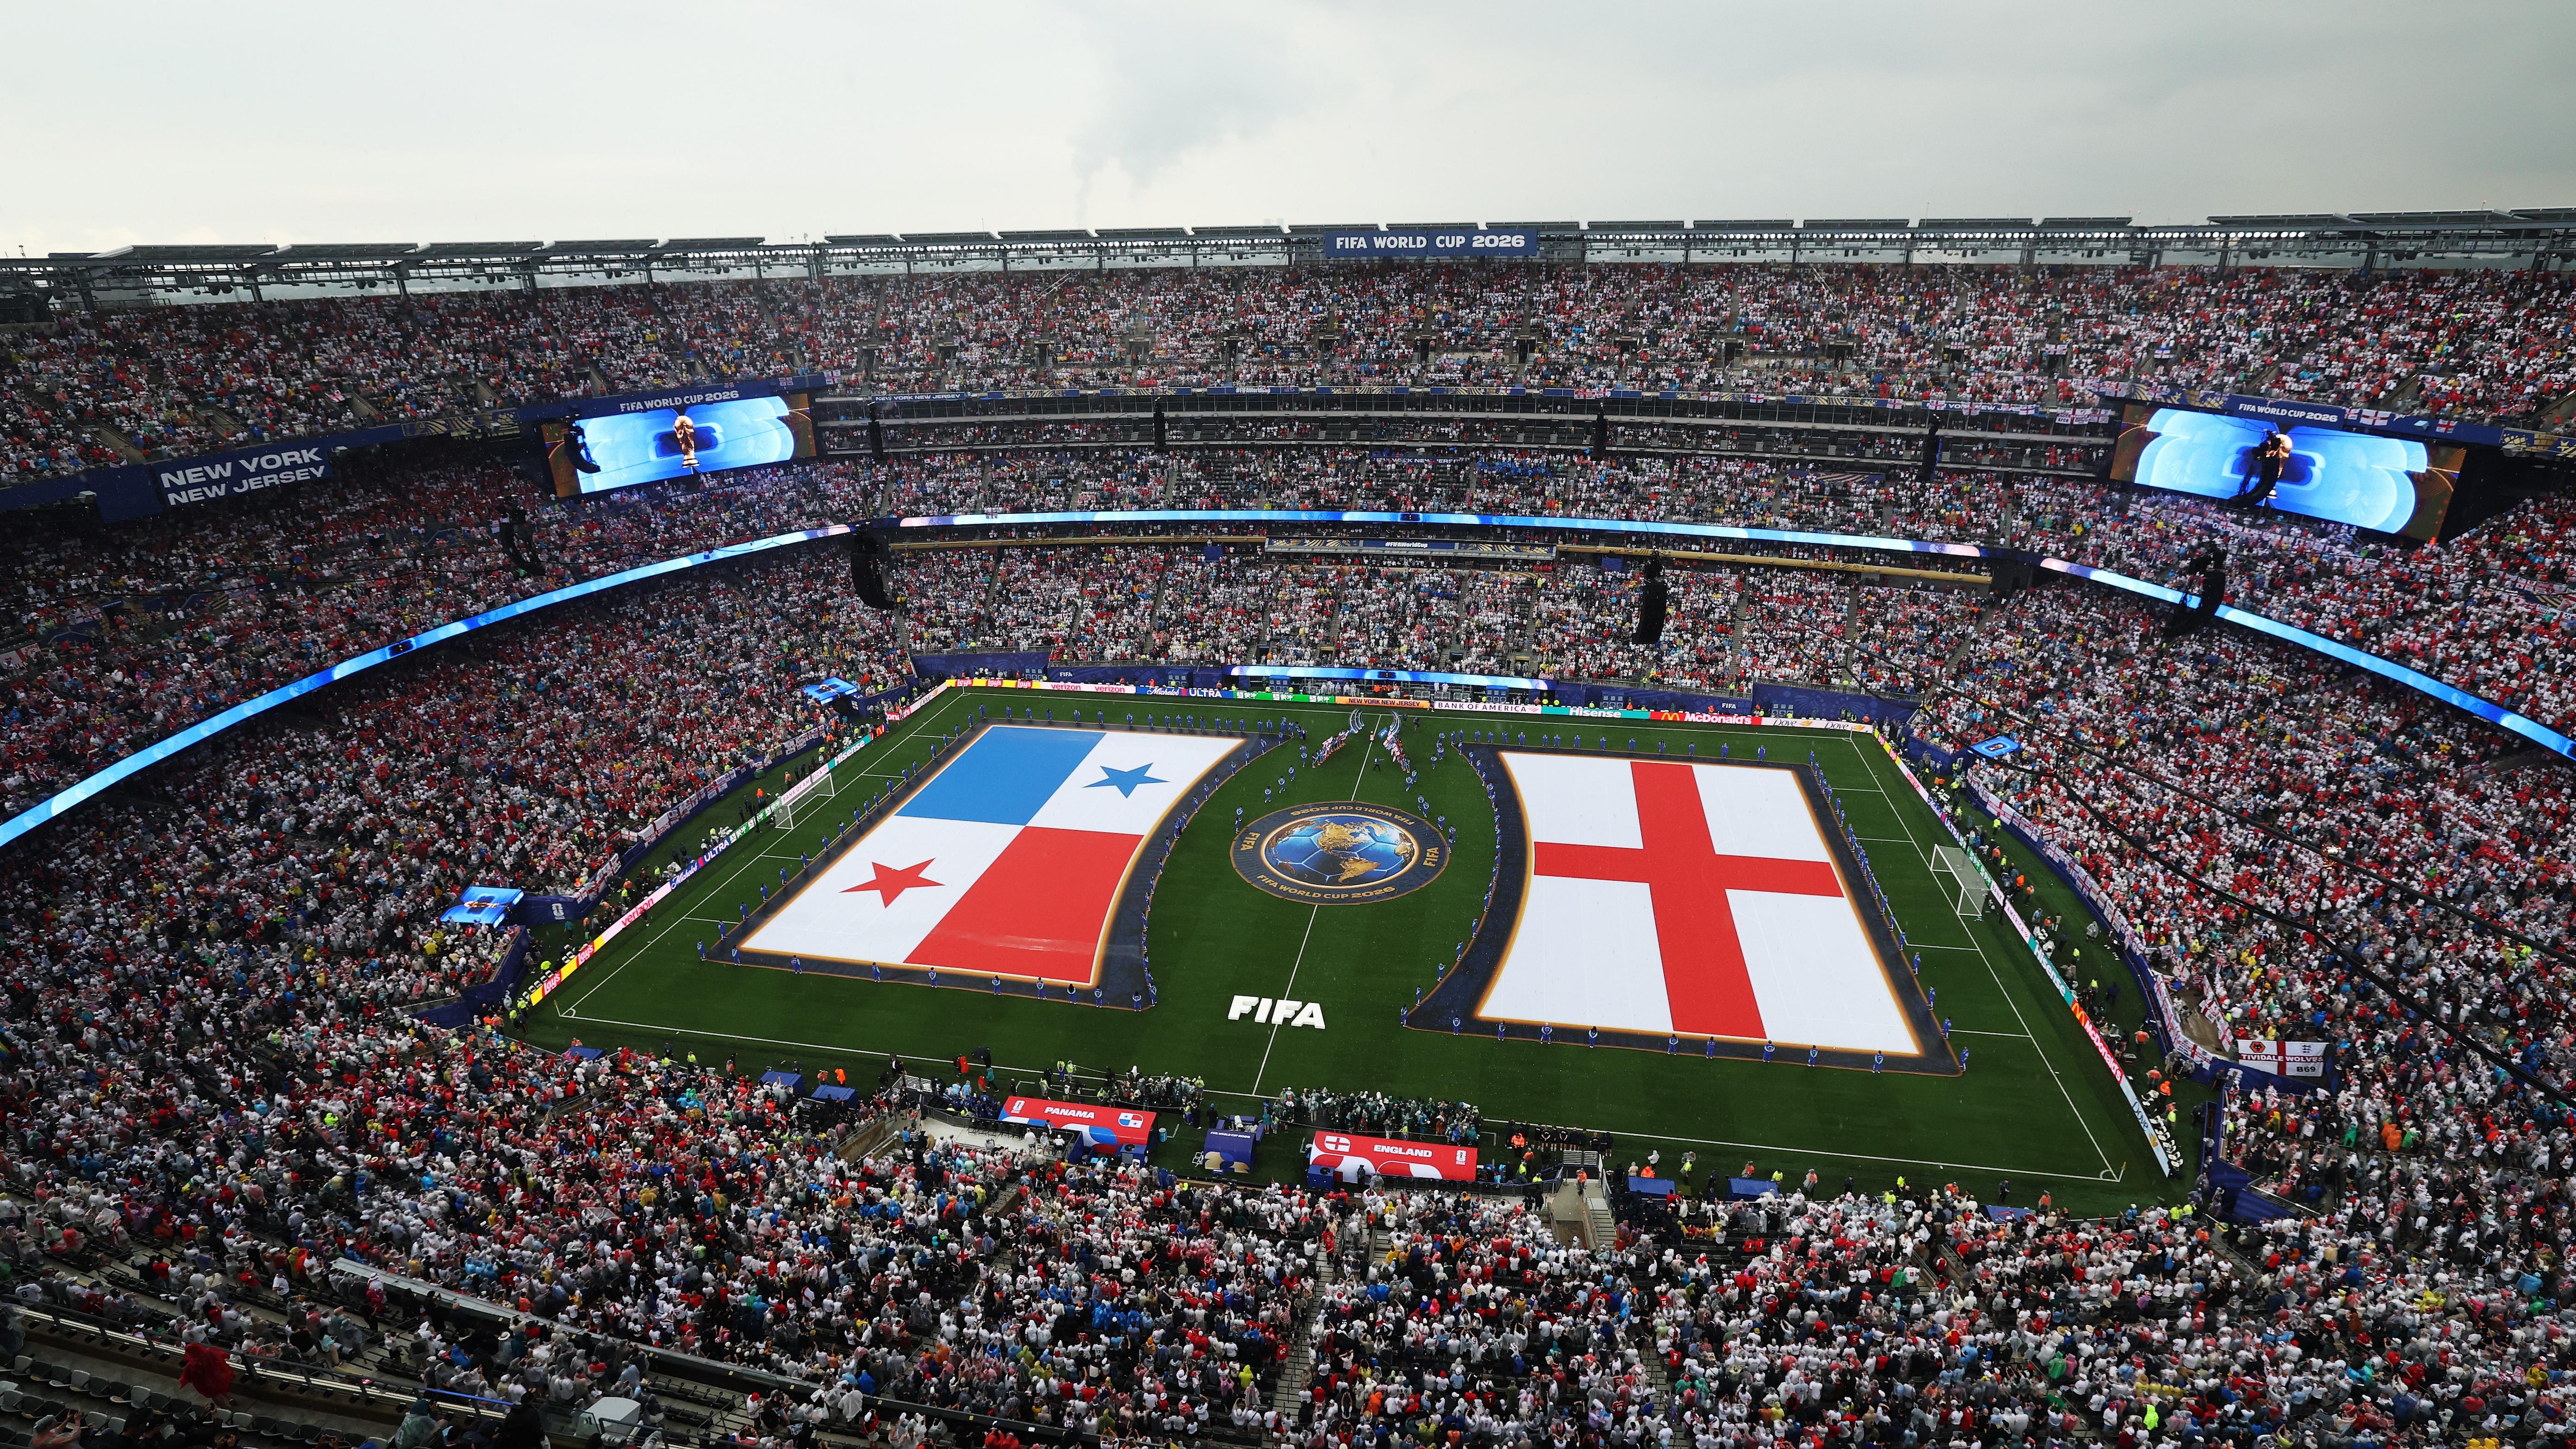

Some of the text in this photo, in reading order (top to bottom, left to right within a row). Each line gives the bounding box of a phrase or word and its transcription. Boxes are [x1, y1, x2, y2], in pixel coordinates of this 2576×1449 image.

[1336, 235, 1525, 249] FIFA WORLD CUP 2026
[620, 390, 739, 412] FIFA WORLD CUP 2026
[2239, 403, 2338, 422] FIFA WORLD CUP 2026
[160, 448, 323, 488] NEW YORK
[167, 465, 325, 506] NEW JERSEY
[1051, 683, 1081, 691] verizon
[1095, 685, 1125, 693] verizon
[1147, 687, 1180, 696] Michelob
[1569, 707, 1621, 718] Hisense
[1684, 713, 1752, 724] McDonald's
[1774, 718, 1797, 727] Dove
[1825, 720, 1849, 730] Dove
[834, 739, 865, 766] Hisense
[783, 789, 795, 802] BANK
[803, 770, 822, 787] AMRICA
[1906, 772, 1920, 791] verizon
[1290, 806, 1329, 816] 2026
[1355, 806, 1393, 819] WORLD
[1394, 814, 1415, 825] FIFA
[1944, 817, 1959, 840] ULTRA
[1240, 832, 1261, 851] FIFA
[671, 836, 731, 890] Michelob ULTRA
[1423, 847, 1439, 867] FIFA
[1257, 874, 1278, 887] FIFA
[1280, 884, 1321, 898] WORLD
[1351, 886, 1396, 899] 2026
[621, 897, 653, 926] verizon
[577, 943, 594, 965] Lay's
[2033, 946, 2066, 997] Hisense
[544, 972, 561, 995] Lay's
[1228, 995, 1325, 1029] FIFA
[2084, 1020, 2122, 1082] McDonald's
[1044, 1107, 1095, 1119] PANAMA
[2132, 1100, 2149, 1131] Dove
[1374, 1144, 1432, 1157] ENGLAND
